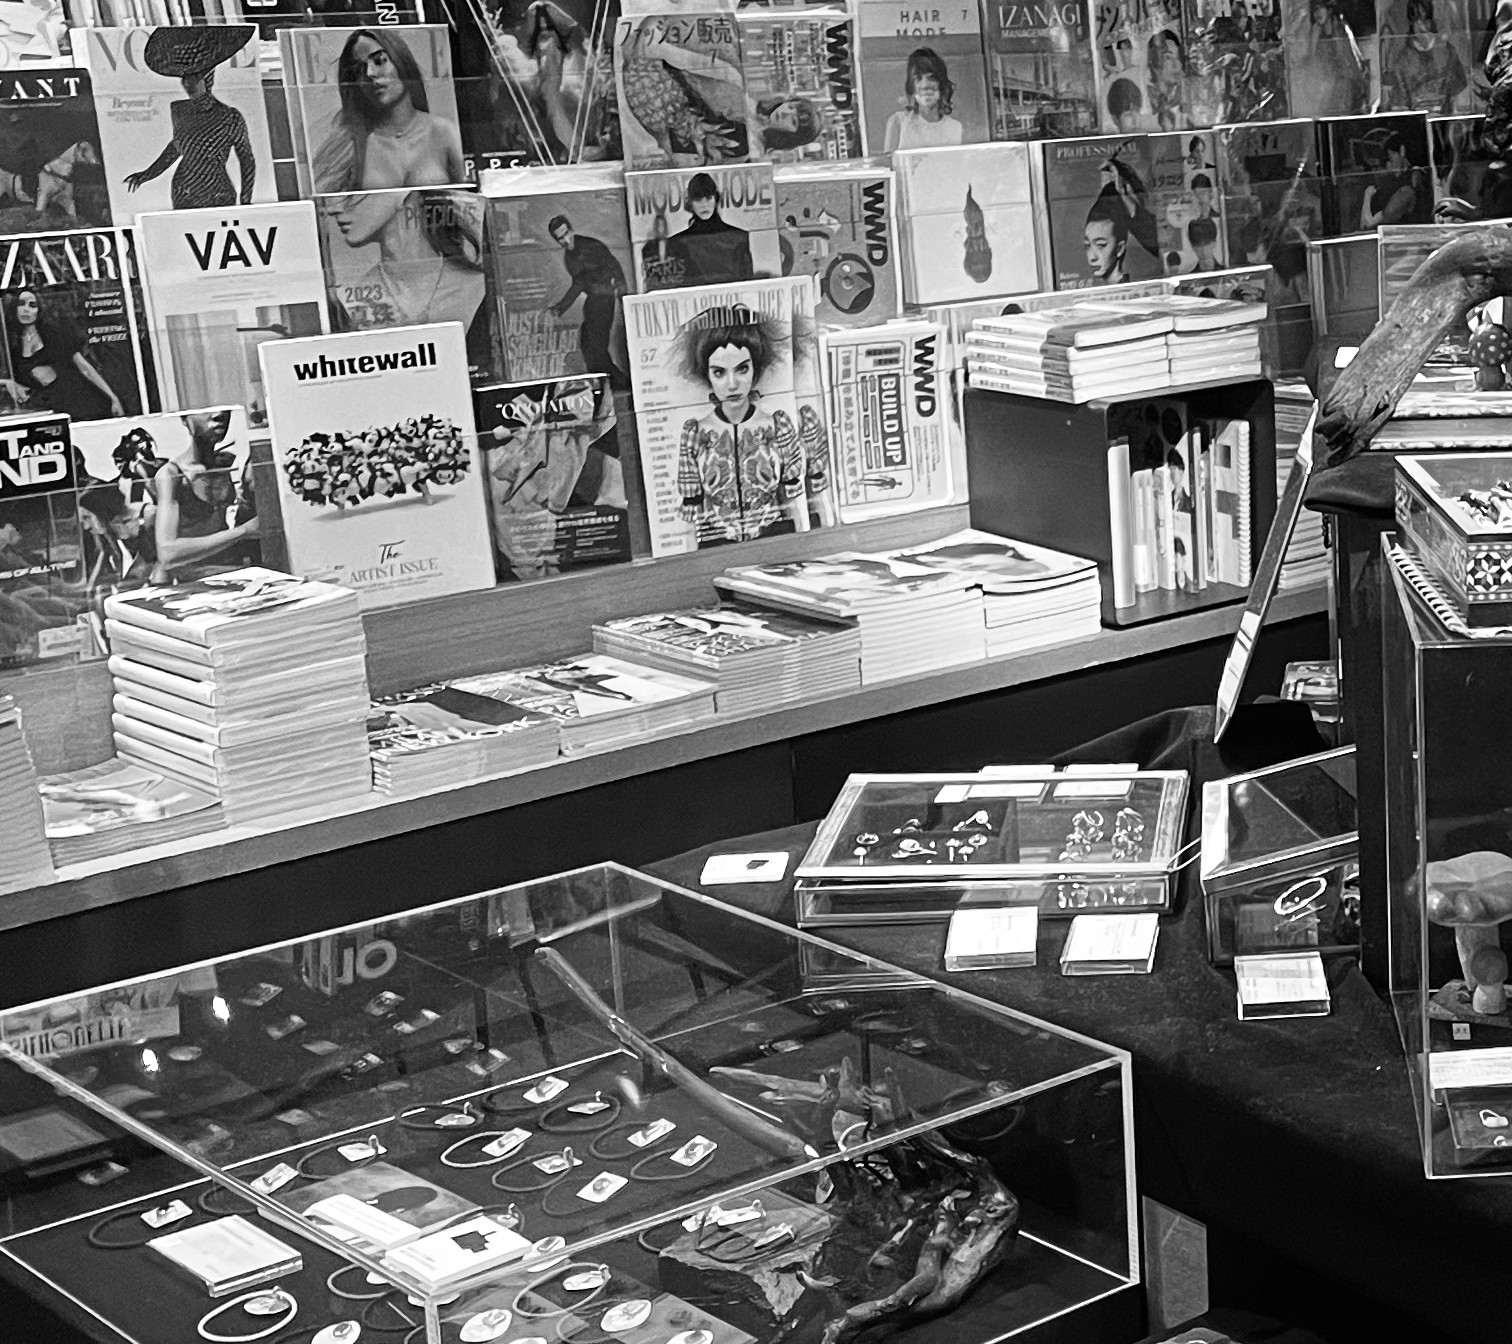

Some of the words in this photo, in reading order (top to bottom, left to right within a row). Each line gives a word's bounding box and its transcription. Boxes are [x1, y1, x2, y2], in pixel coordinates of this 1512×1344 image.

[899, 9, 940, 23] HAIR
[825, 21, 853, 109] WWD
[10, 77, 80, 100] ANT
[863, 181, 888, 267] WWD
[185, 220, 278, 271] VÄV
[345, 284, 383, 304] 2023
[631, 297, 680, 338] TOKYO
[294, 342, 437, 382] whitewall
[913, 334, 937, 418] WWD
[881, 375, 900, 435] BUILD
[20, 441, 65, 458] AND
[884, 436, 903, 464] UP
[379, 540, 406, 565] The
[349, 564, 395, 584] ARTIST
[399, 557, 439, 575] ISSUE
